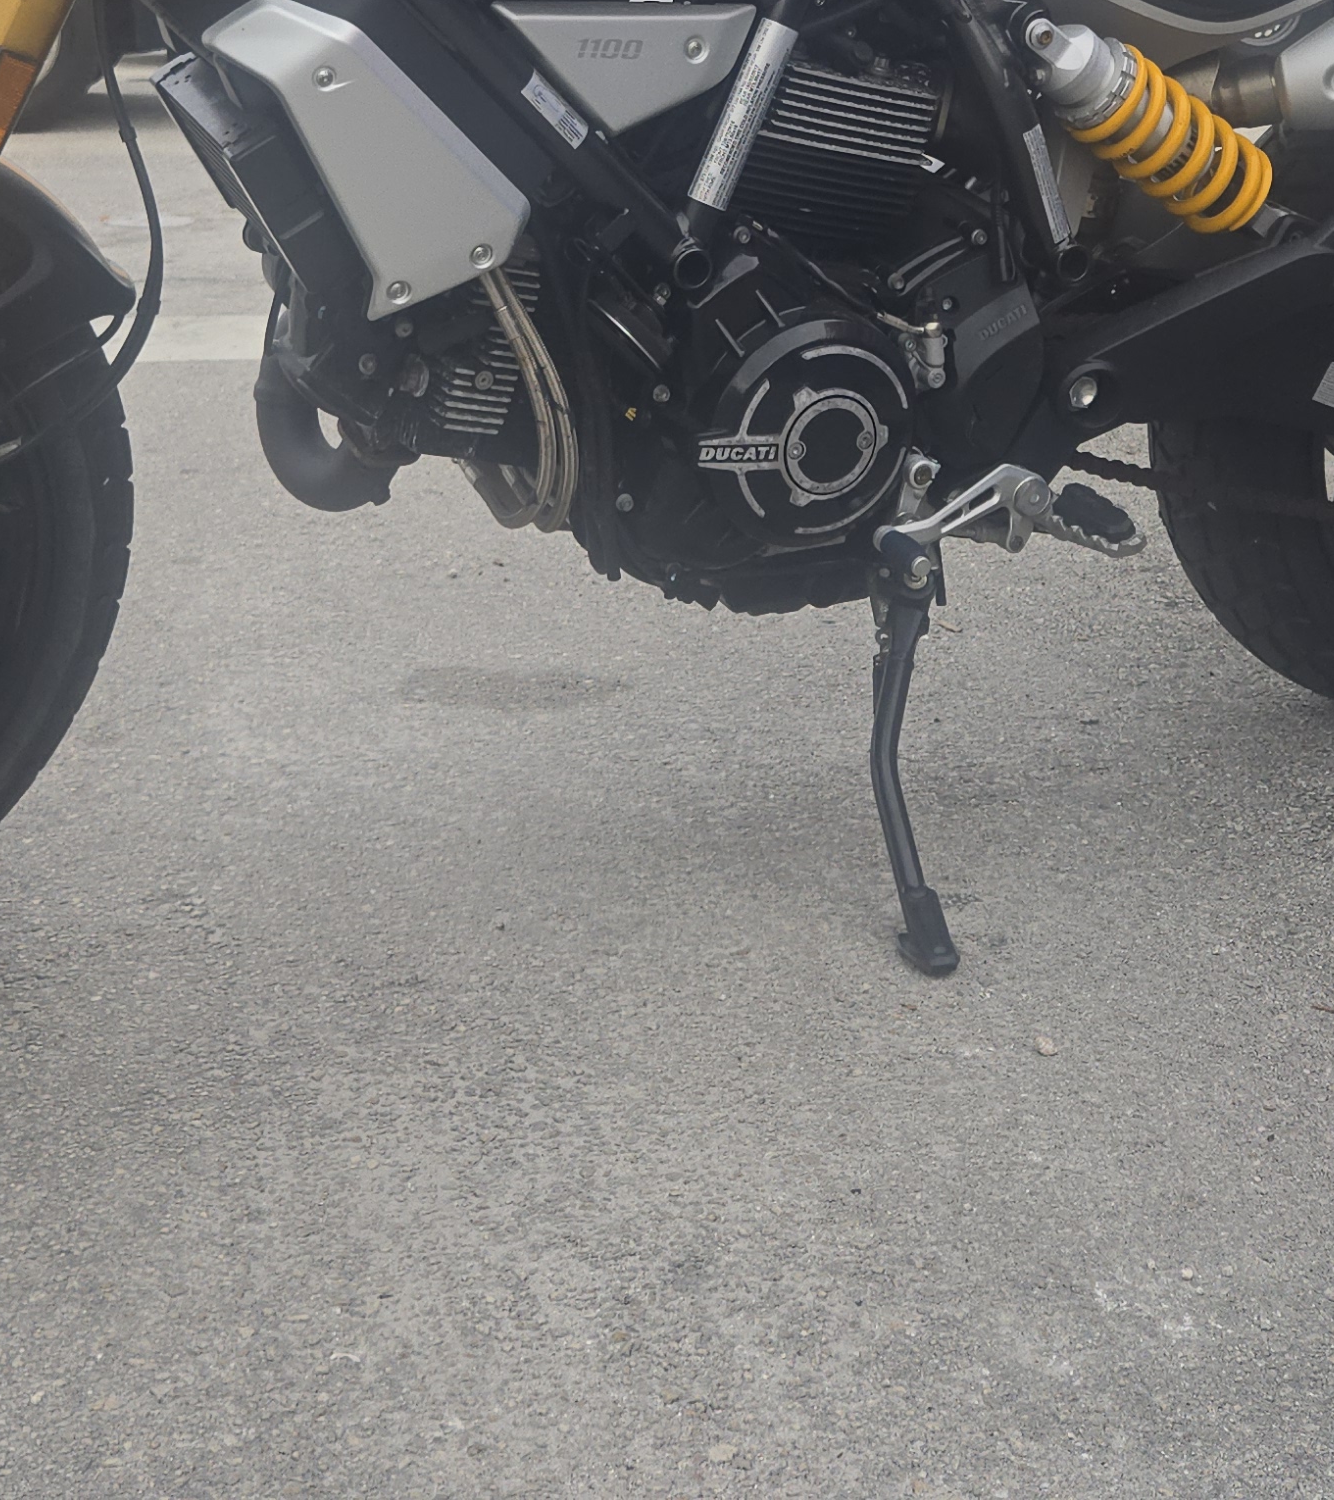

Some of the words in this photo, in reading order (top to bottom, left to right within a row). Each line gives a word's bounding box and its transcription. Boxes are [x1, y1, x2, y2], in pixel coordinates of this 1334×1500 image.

[577, 38, 643, 60] 1100
[979, 304, 1027, 340] DUCATI
[699, 445, 777, 462] DUCATI
